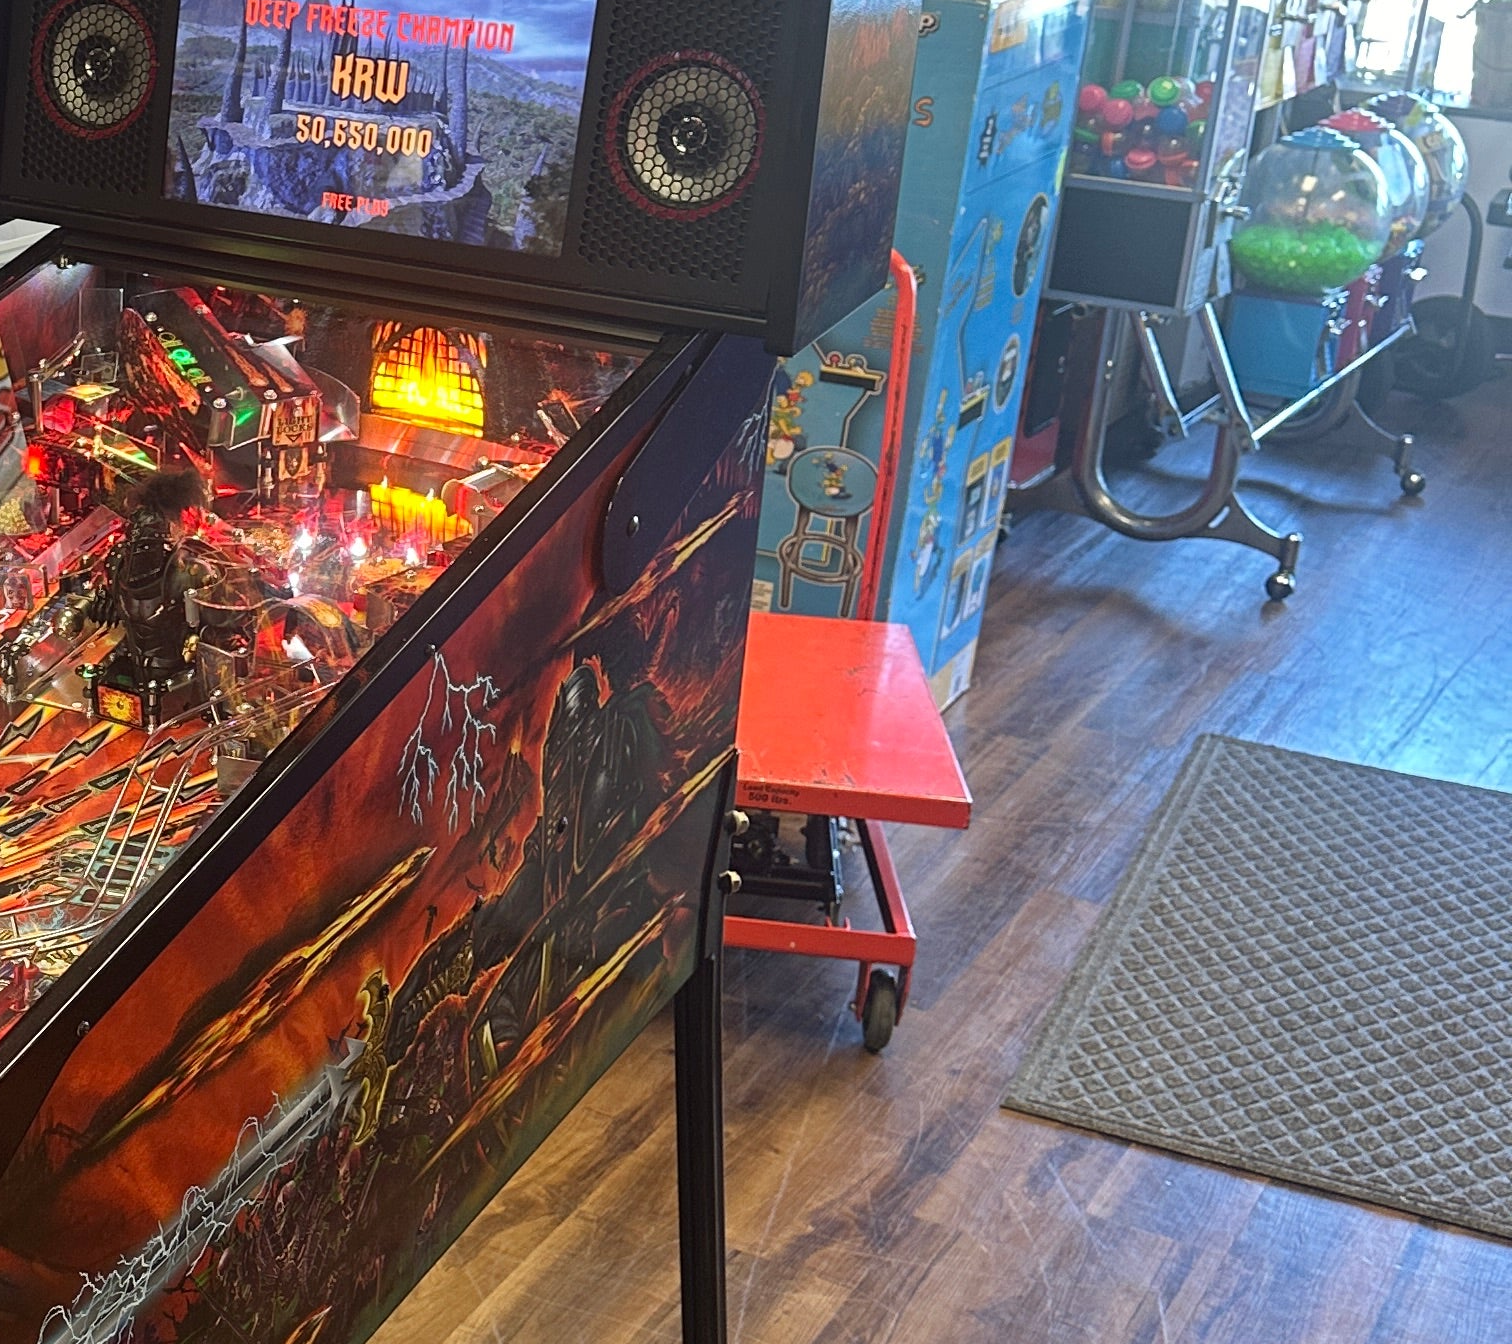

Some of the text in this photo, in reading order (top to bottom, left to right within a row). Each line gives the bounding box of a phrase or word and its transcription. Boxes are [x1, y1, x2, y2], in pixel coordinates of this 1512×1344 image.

[306, 3, 390, 40] FREEZE
[396, 12, 516, 53] CHAMPION
[331, 53, 410, 105] KRW
[295, 113, 433, 159] 50,650,000
[321, 191, 390, 218] FREE PLAY
